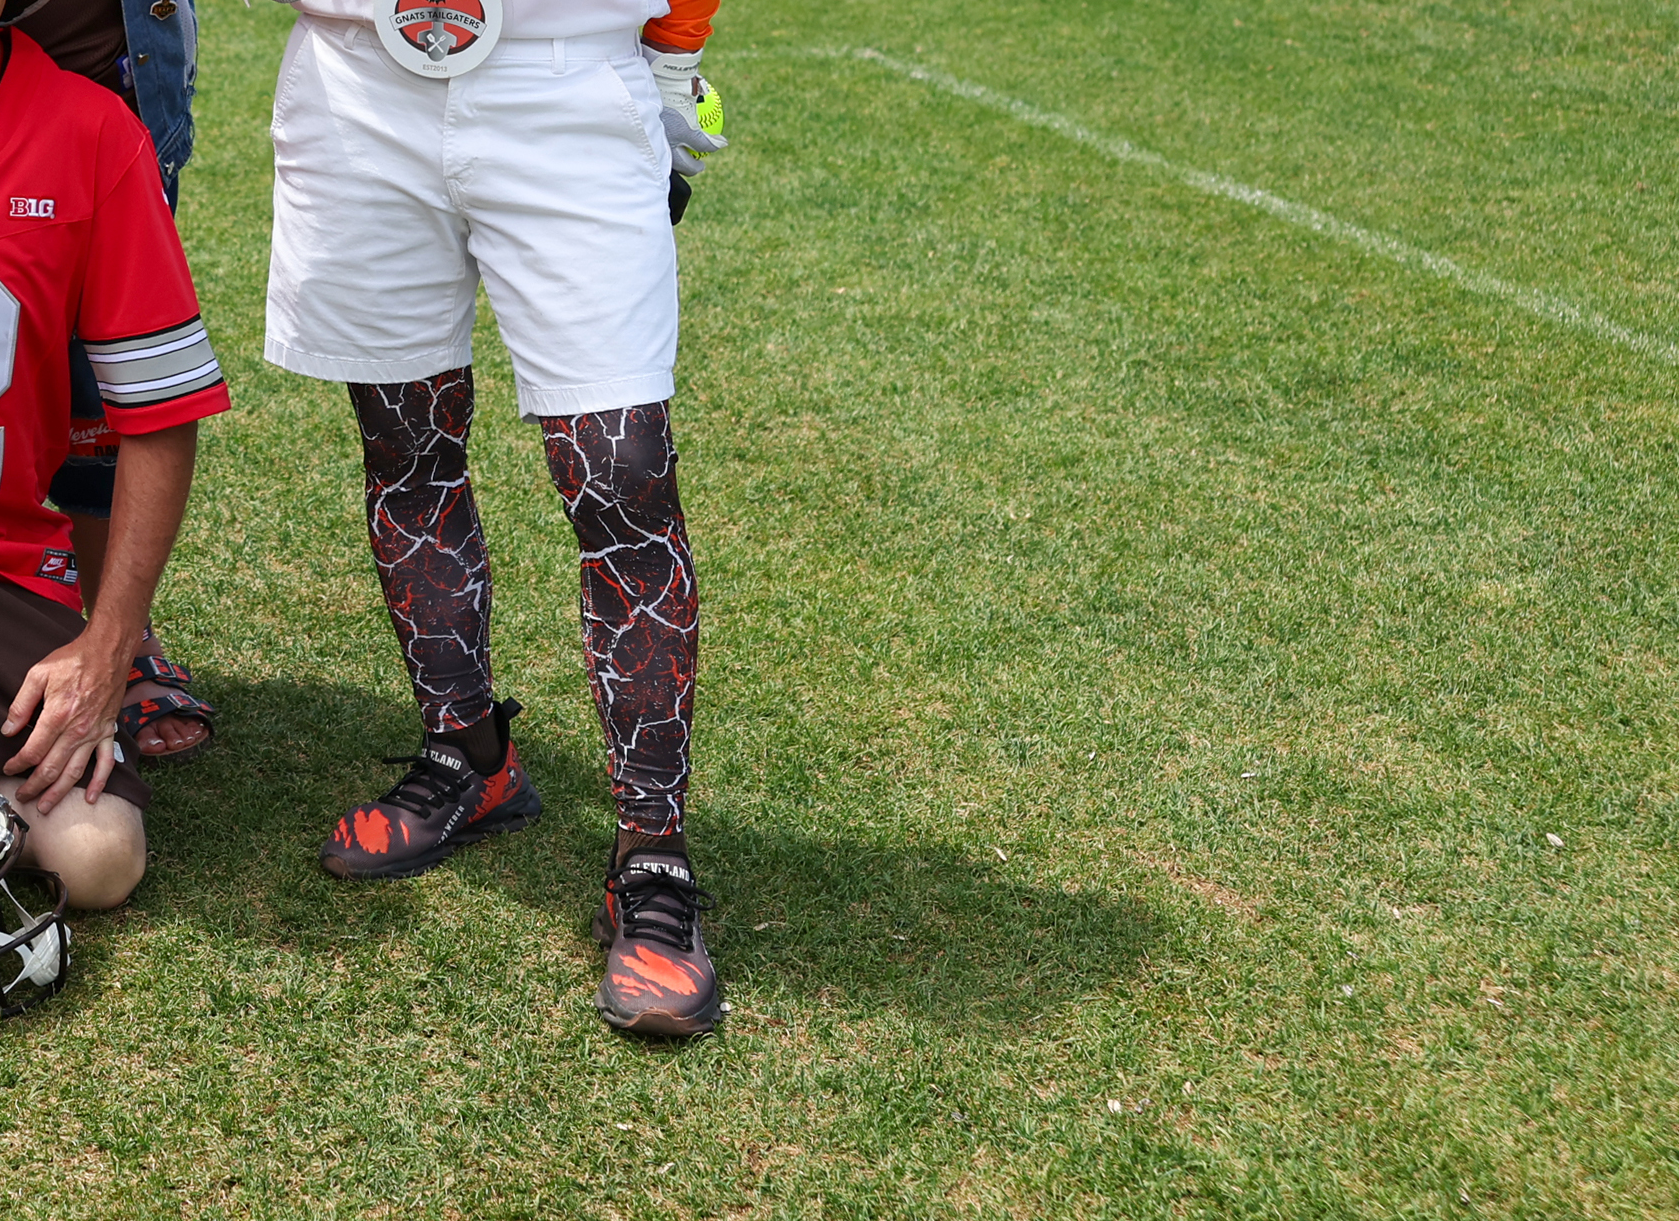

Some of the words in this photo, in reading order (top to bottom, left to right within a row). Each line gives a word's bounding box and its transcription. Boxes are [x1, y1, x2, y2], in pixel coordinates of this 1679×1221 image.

[395, 10, 425, 25] GNATS
[427, 10, 481, 30] TAILGATERS
[422, 64, 448, 73] EST2013
[10, 197, 54, 217] B1G
[444, 805, 465, 832] WEBER
